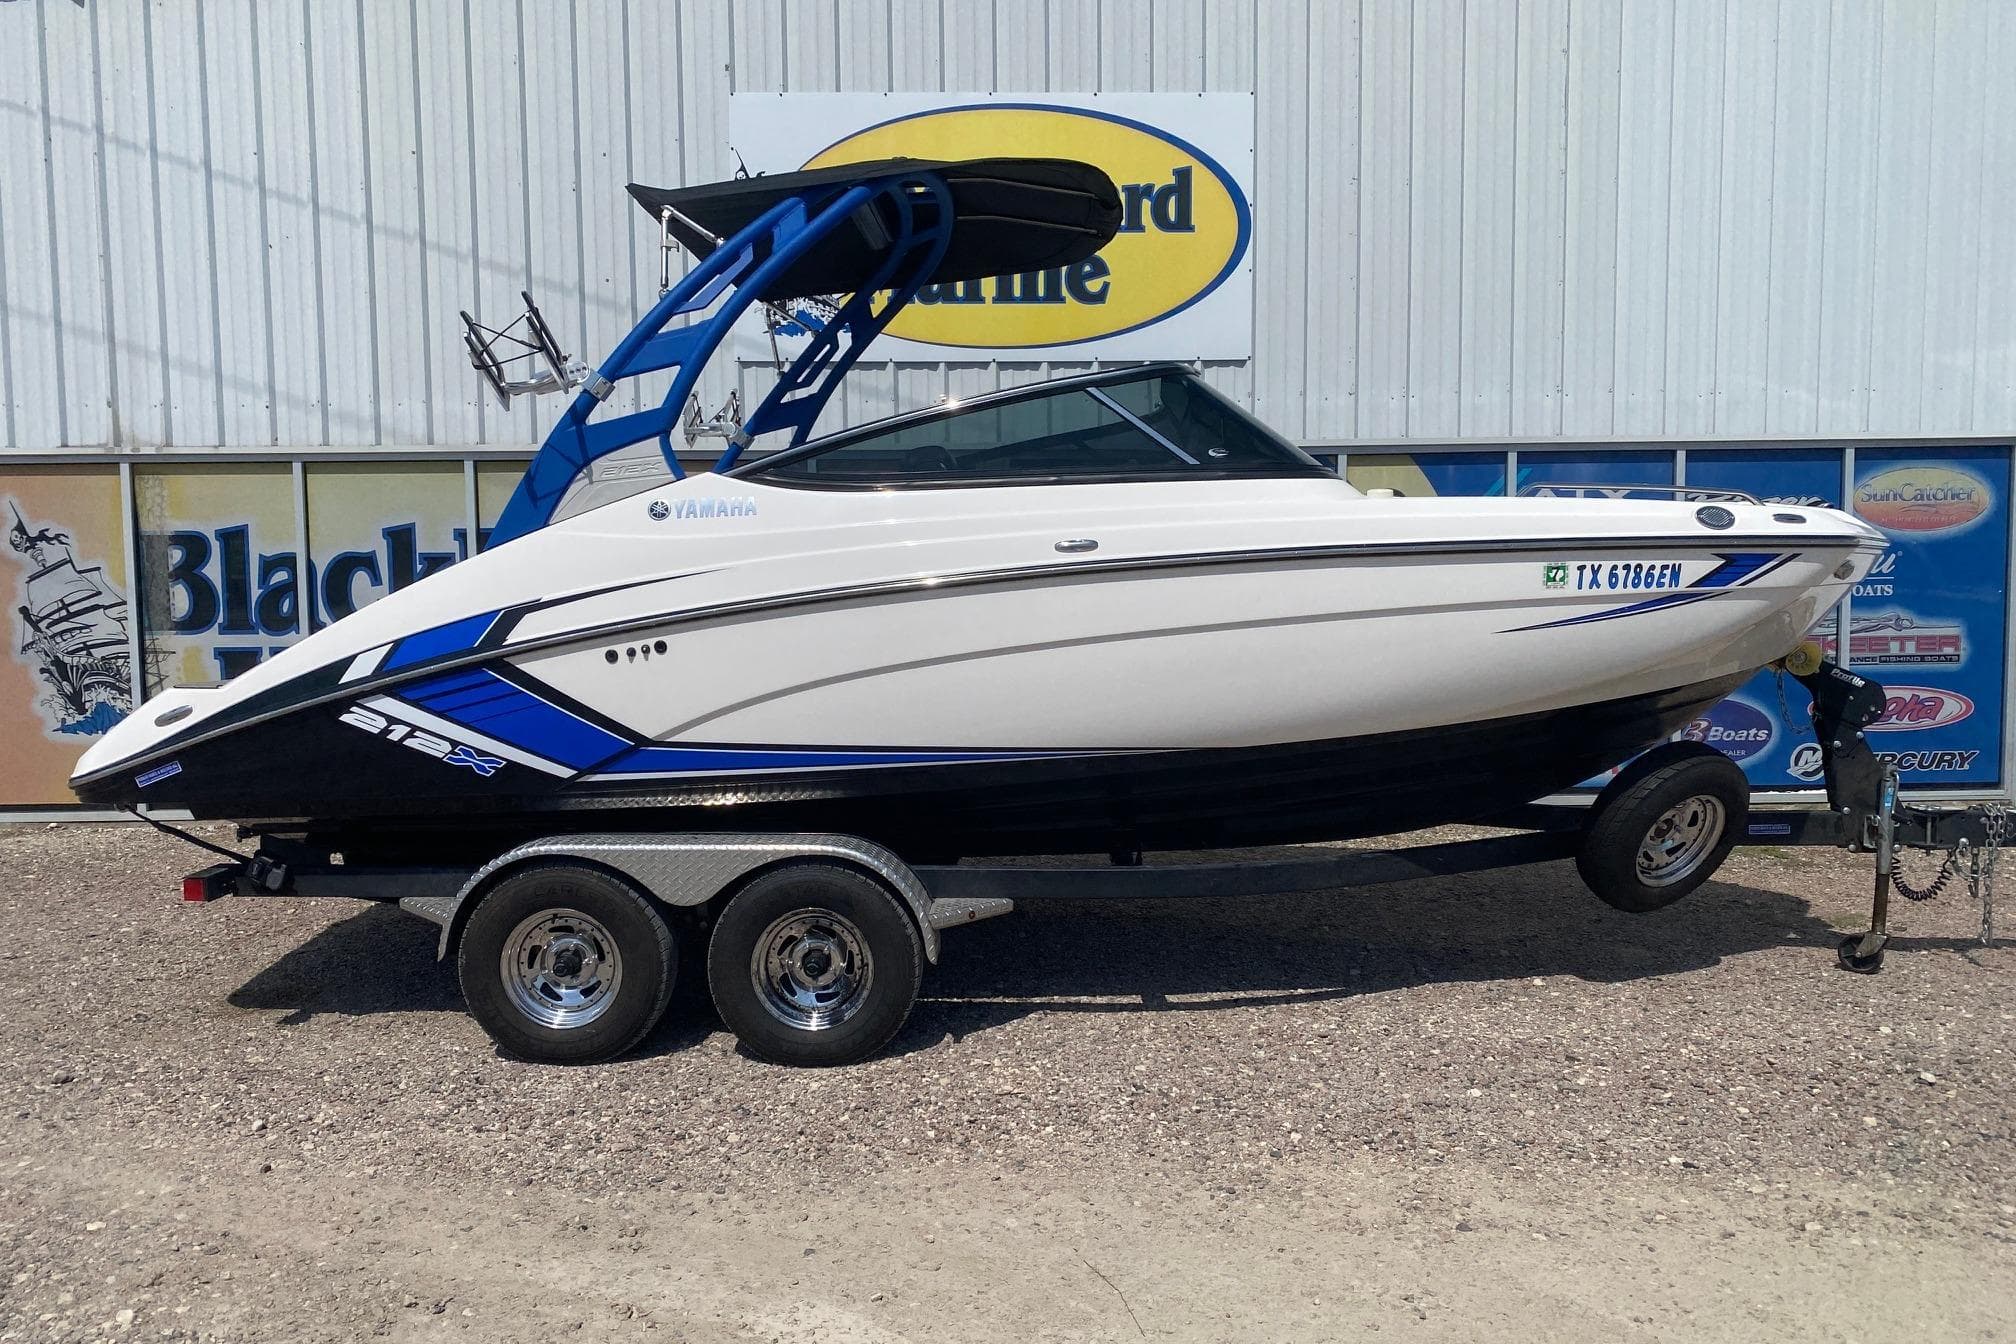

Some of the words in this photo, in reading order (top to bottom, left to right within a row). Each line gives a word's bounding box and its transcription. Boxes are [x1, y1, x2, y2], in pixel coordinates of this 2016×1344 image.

[1117, 166, 1195, 233] rd
[1861, 482, 1976, 503] SunCatcher
[674, 496, 758, 519] YAMAHA
[1577, 563, 1603, 590] TX
[1607, 563, 1682, 590] 6786EN
[1852, 585, 1894, 596] OATS
[338, 706, 507, 777] 212X
[1708, 726, 1769, 741] Boats
